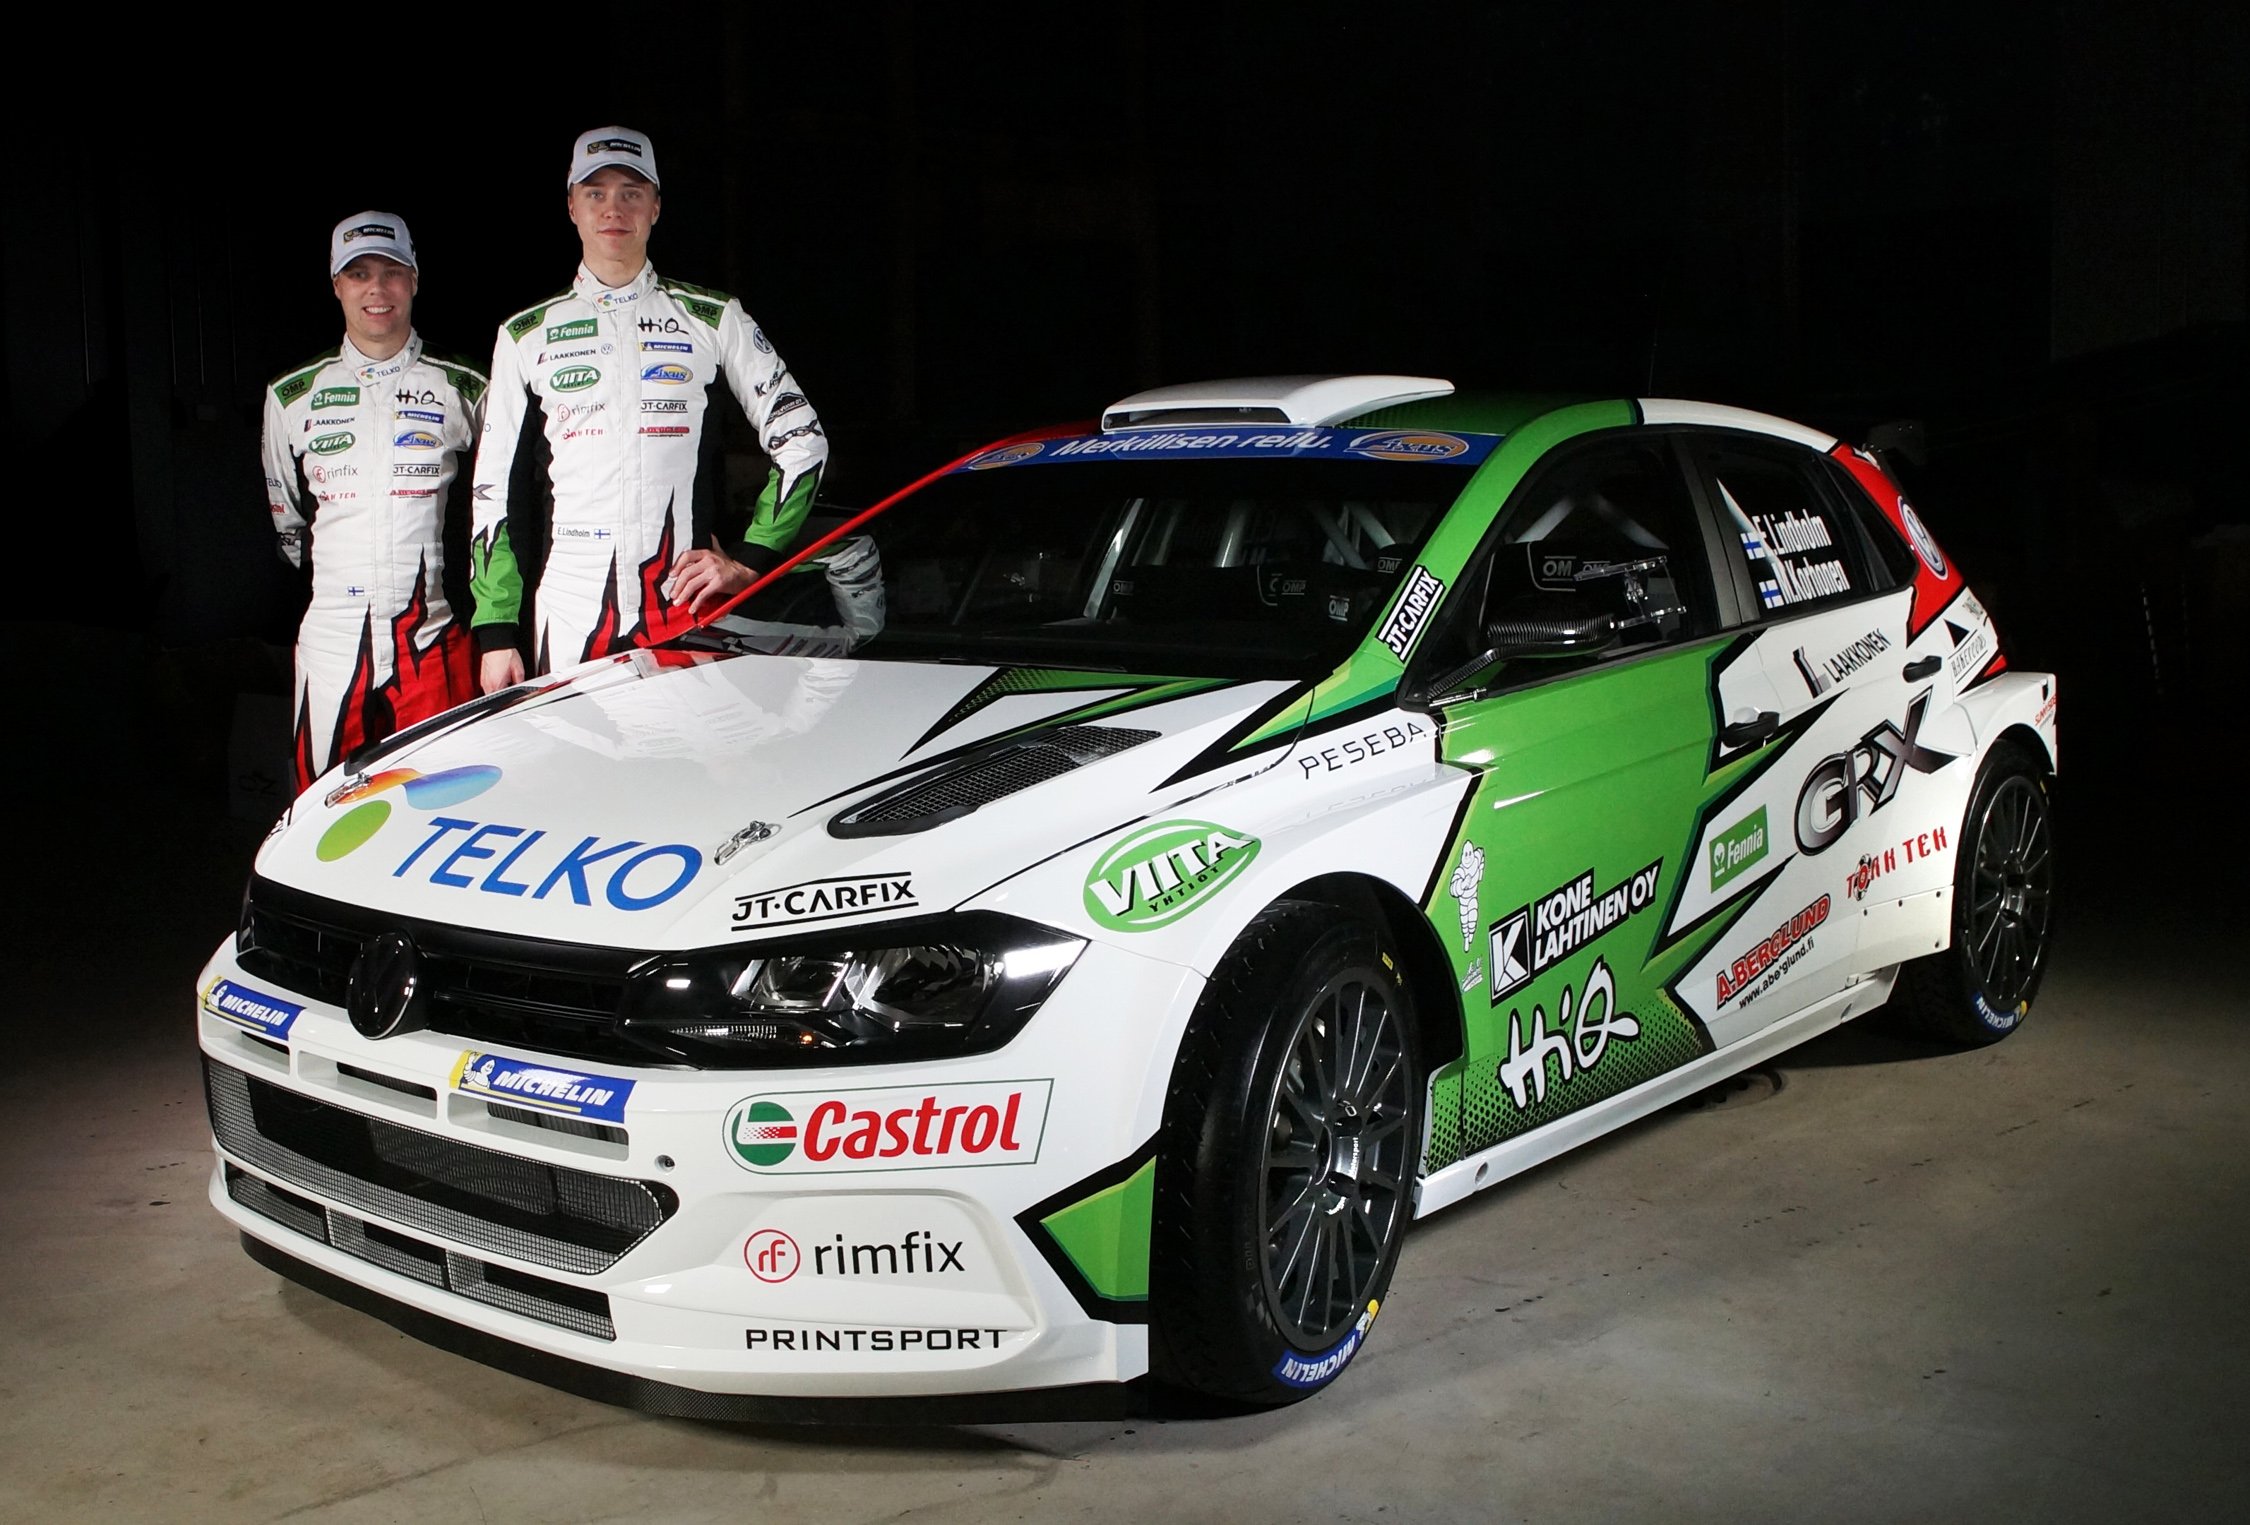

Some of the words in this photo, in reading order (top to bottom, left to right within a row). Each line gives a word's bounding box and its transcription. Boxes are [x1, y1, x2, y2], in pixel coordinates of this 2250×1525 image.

[614, 292, 639, 305] TELKO
[560, 324, 595, 338] Fennia
[638, 316, 689, 335] HiQ
[376, 365, 401, 378] TELKO
[550, 349, 596, 361] LAAKKONEN
[552, 370, 599, 387] VIITA
[324, 391, 357, 405] Fennia
[395, 388, 445, 406] HiQ
[311, 433, 354, 450] VIITA
[1050, 431, 1241, 457] Merkillisen
[1542, 560, 1573, 577] OM
[1329, 598, 1348, 617] OMP
[1822, 628, 1892, 684] LAAKKONEN
[1298, 722, 1428, 780] PESEBA
[1794, 684, 1960, 857] GRX
[1726, 823, 1764, 870] Fennia
[393, 816, 704, 912] TELKO
[1088, 831, 1257, 917] VIITA
[1534, 884, 1629, 971] LAHTINEN
[1631, 865, 1659, 907] OY
[1537, 875, 1592, 936] KONE
[1717, 895, 1831, 1008] A.BERGLUND
[220, 994, 290, 1027] MICHELIN
[1976, 996, 2015, 1029] MICHELIN
[1500, 960, 1640, 1109] HiQ
[494, 1071, 614, 1107] MICHELIN
[803, 1092, 1021, 1163] Castrol
[814, 1231, 966, 1275] rimfix
[745, 1328, 1008, 1350] PRINTSPORT
[1281, 1334, 1356, 1382] MICHELIN
